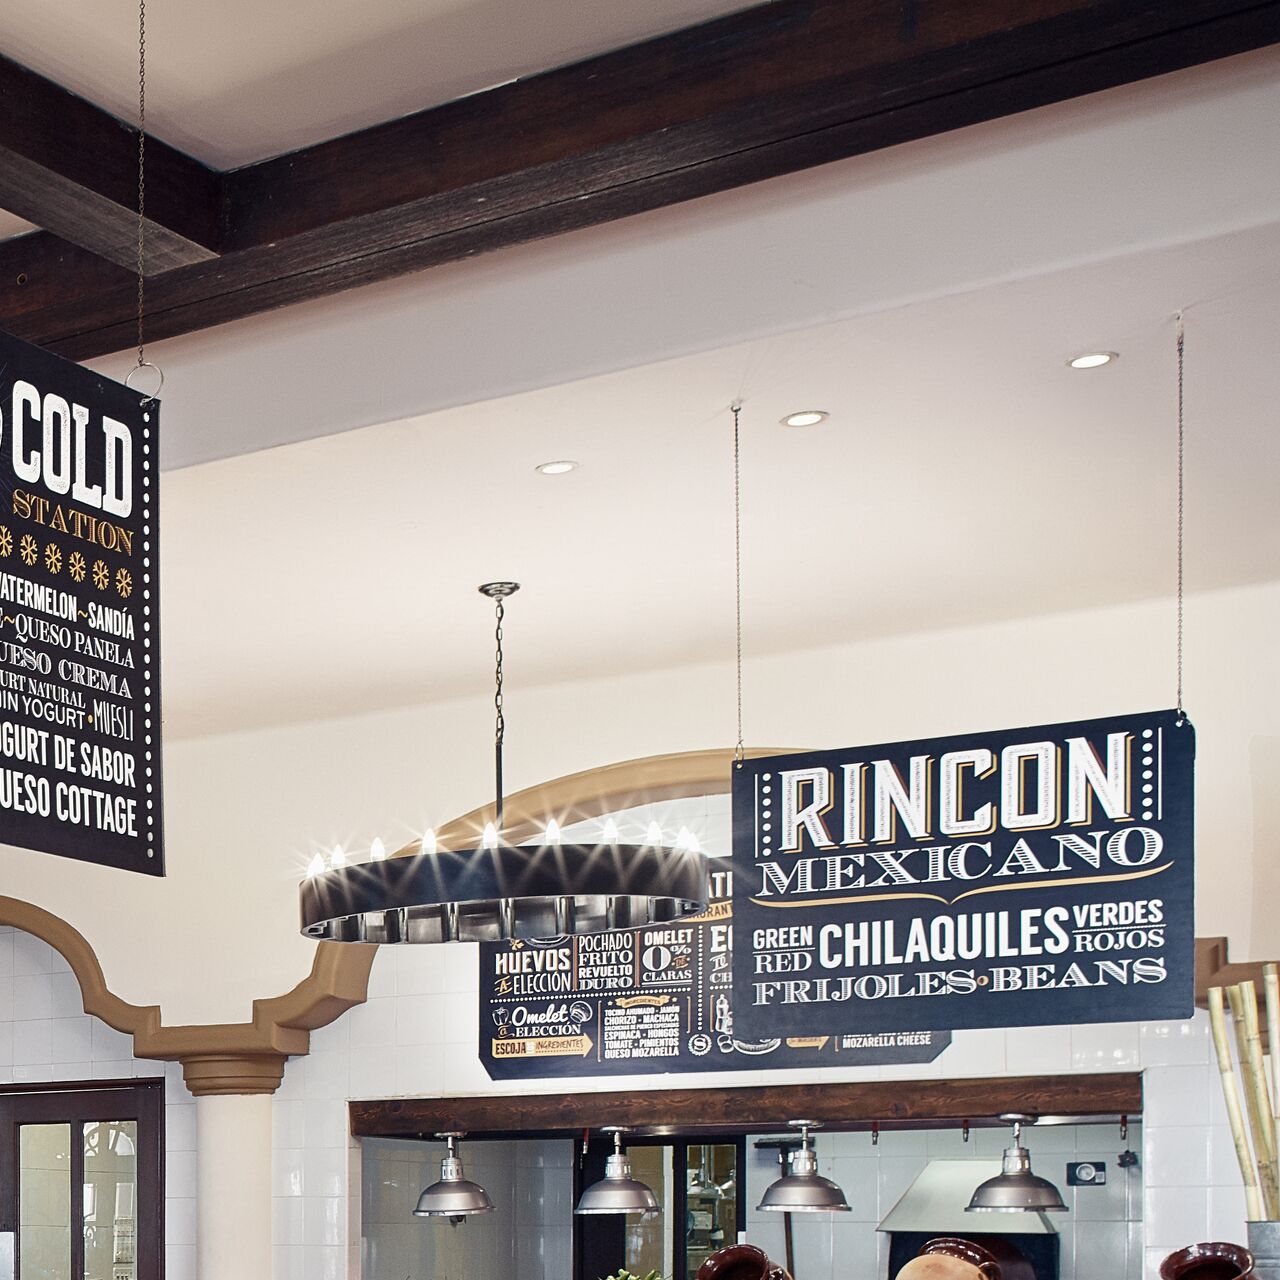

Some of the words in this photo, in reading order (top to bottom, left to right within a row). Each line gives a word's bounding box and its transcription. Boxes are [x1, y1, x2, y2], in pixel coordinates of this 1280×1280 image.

[12, 379, 134, 519] COLD
[12, 489, 134, 557] STATION
[88, 601, 135, 641] SANDÍA
[15, 613, 71, 644] QUESO
[74, 630, 135, 669] PANELA
[58, 659, 133, 699] CREMA
[28, 678, 86, 709] NATURAL
[22, 695, 85, 730] YOGURT
[93, 699, 134, 741] MUESLI
[54, 735, 76, 773] DE
[81, 742, 136, 788] SABOR
[778, 732, 1134, 854] RINCON
[56, 782, 138, 837] COTTAGE
[755, 826, 1164, 898] MEXICANO
[1073, 899, 1163, 927] VERDES
[579, 933, 632, 953] POCHADO
[645, 929, 693, 946] OMELET
[753, 925, 813, 950] GREEN
[819, 906, 1072, 968] CHILAQUILES
[1073, 929, 1165, 953] ROJOS
[495, 948, 571, 975] HUEVOS
[578, 950, 633, 966] FRITO
[754, 951, 813, 974] RED
[513, 971, 571, 995] ELECCIÓN
[579, 964, 633, 979] REVUELTO
[643, 970, 692, 982] CLARAS
[752, 970, 978, 1006] FRIJOLES
[989, 957, 1167, 993] BEANS
[579, 977, 633, 991] DURO
[512, 1003, 568, 1027] Omelet
[604, 1016, 636, 1026] CHORIZO
[643, 1014, 679, 1023] MACHACA
[515, 1022, 581, 1037] ELECCIÓN
[604, 1030, 641, 1040] ESPINACA
[647, 1028, 680, 1038] HONGOS
[842, 1035, 896, 1048] MOZARELLA
[897, 1034, 931, 1046] CHEESE
[495, 1043, 526, 1055] ESCOJA
[604, 1049, 631, 1059] QUESO
[632, 1047, 679, 1058] MOZARELLA
[605, 1040, 633, 1049] TOMATE
[639, 1038, 679, 1048] PIMIENTOS
